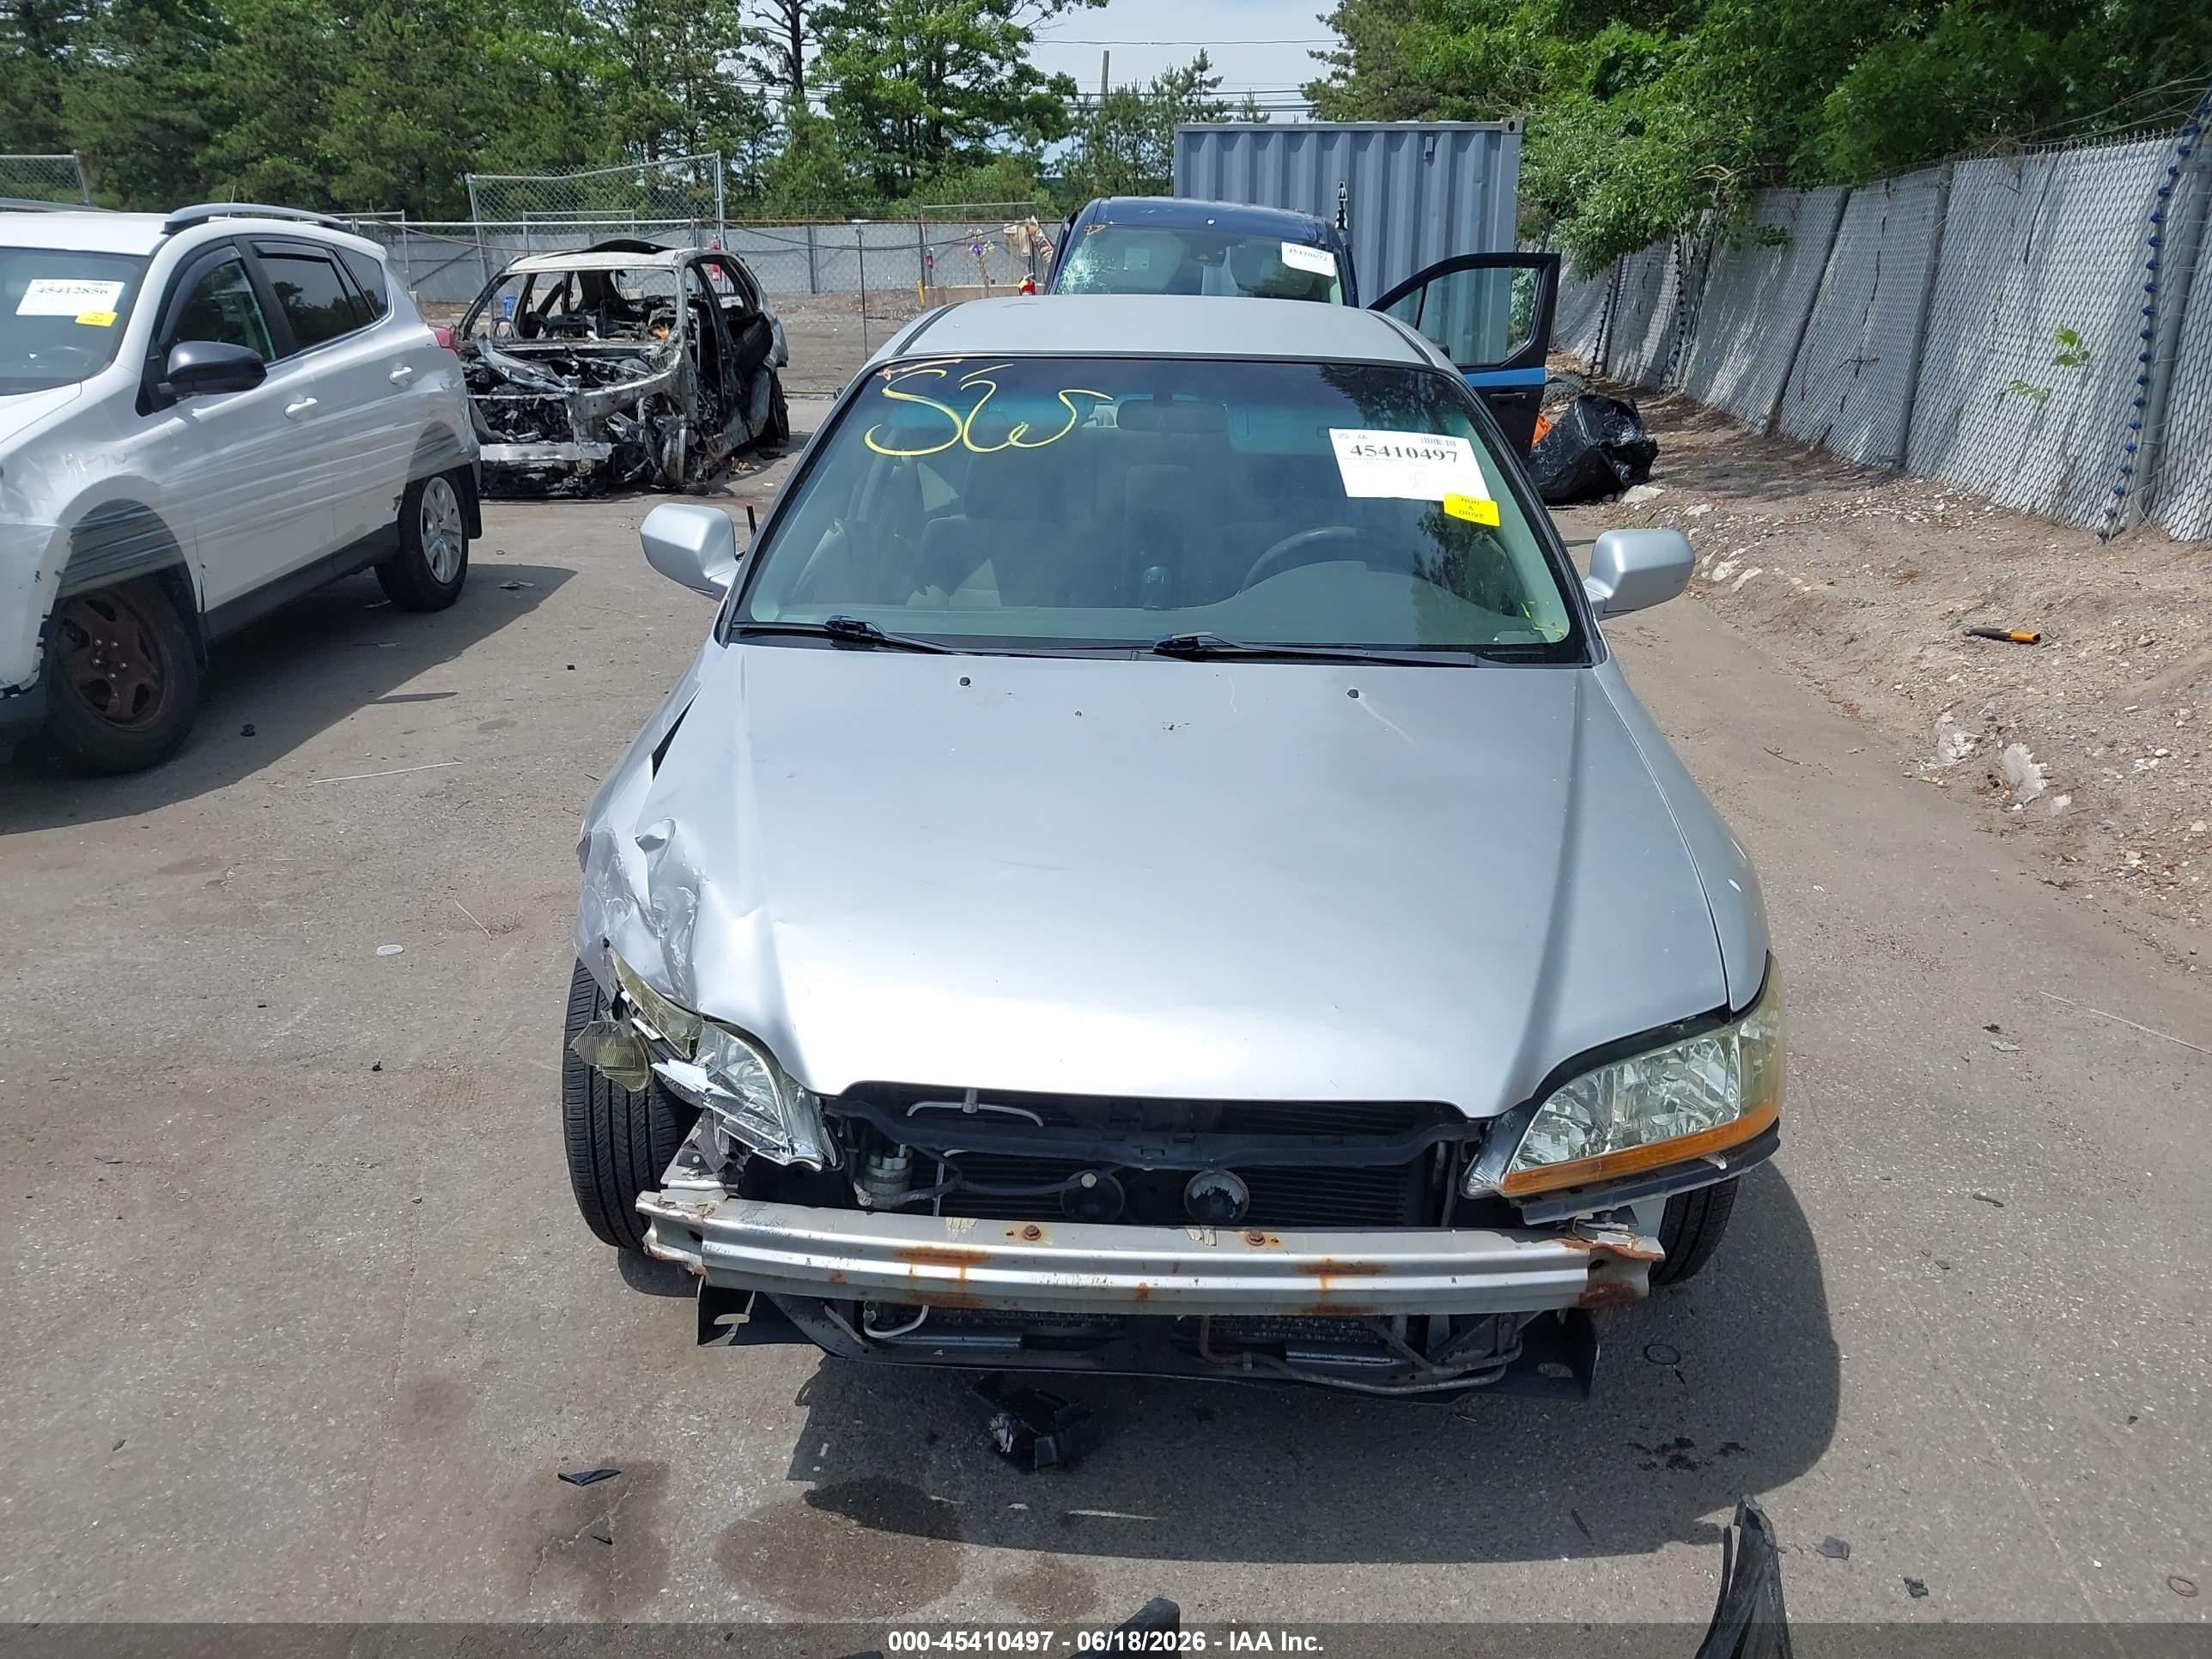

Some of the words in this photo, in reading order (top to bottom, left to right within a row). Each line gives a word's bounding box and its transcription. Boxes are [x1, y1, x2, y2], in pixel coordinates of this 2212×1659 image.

[1350, 444, 1458, 464] 45410497
[1461, 497, 1480, 506] RUN
[1458, 509, 1486, 520] DRIVE
